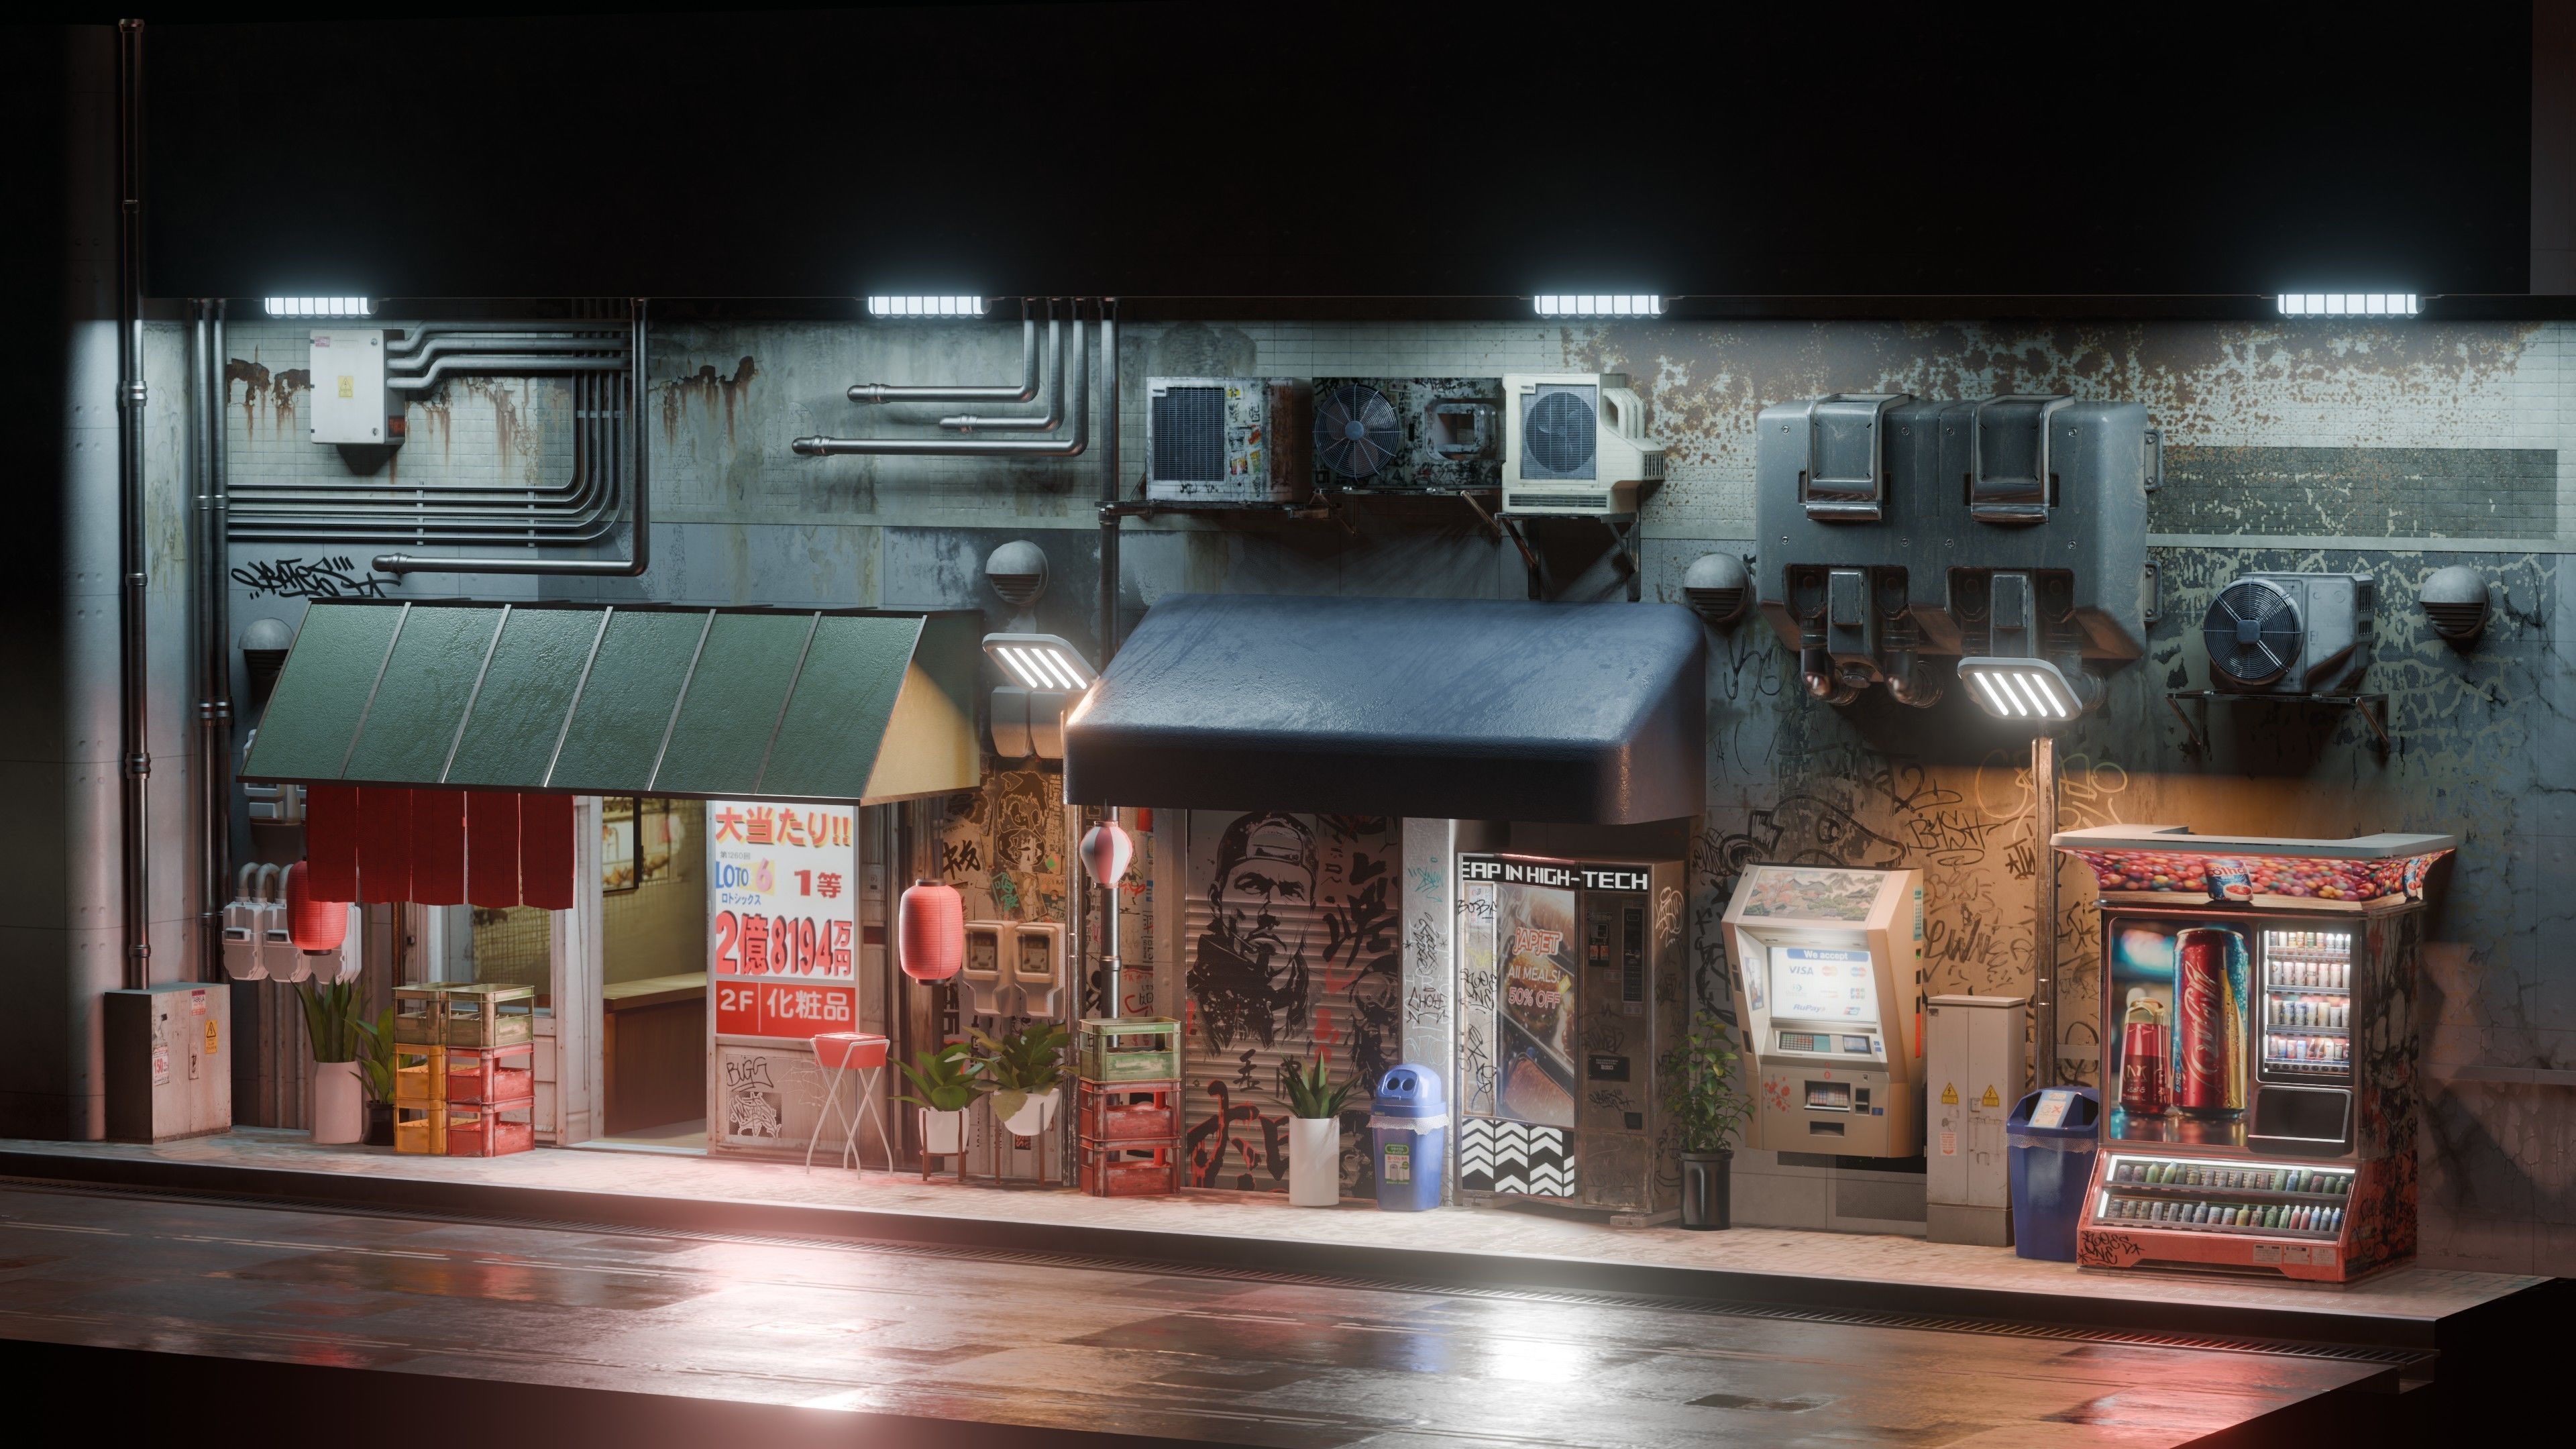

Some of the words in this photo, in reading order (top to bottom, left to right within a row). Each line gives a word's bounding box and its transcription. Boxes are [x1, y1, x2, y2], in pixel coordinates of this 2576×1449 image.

[715, 806, 852, 848] 大当たり!!
[715, 861, 749, 889] LOTO
[756, 857, 772, 892] 6
[1505, 864, 1522, 881] IN
[721, 893, 761, 906] ロトシックス
[1803, 950, 1818, 959] We
[1820, 951, 1849, 961] accept
[1523, 967, 1561, 984] MEALS!
[1789, 965, 1814, 975] VISA
[720, 989, 754, 1012] 2F
[767, 988, 849, 1021] 化粧品
[1508, 987, 1534, 1006] 50%
[1536, 989, 1562, 1009] OFF
[1793, 1004, 1822, 1013] RuPay
